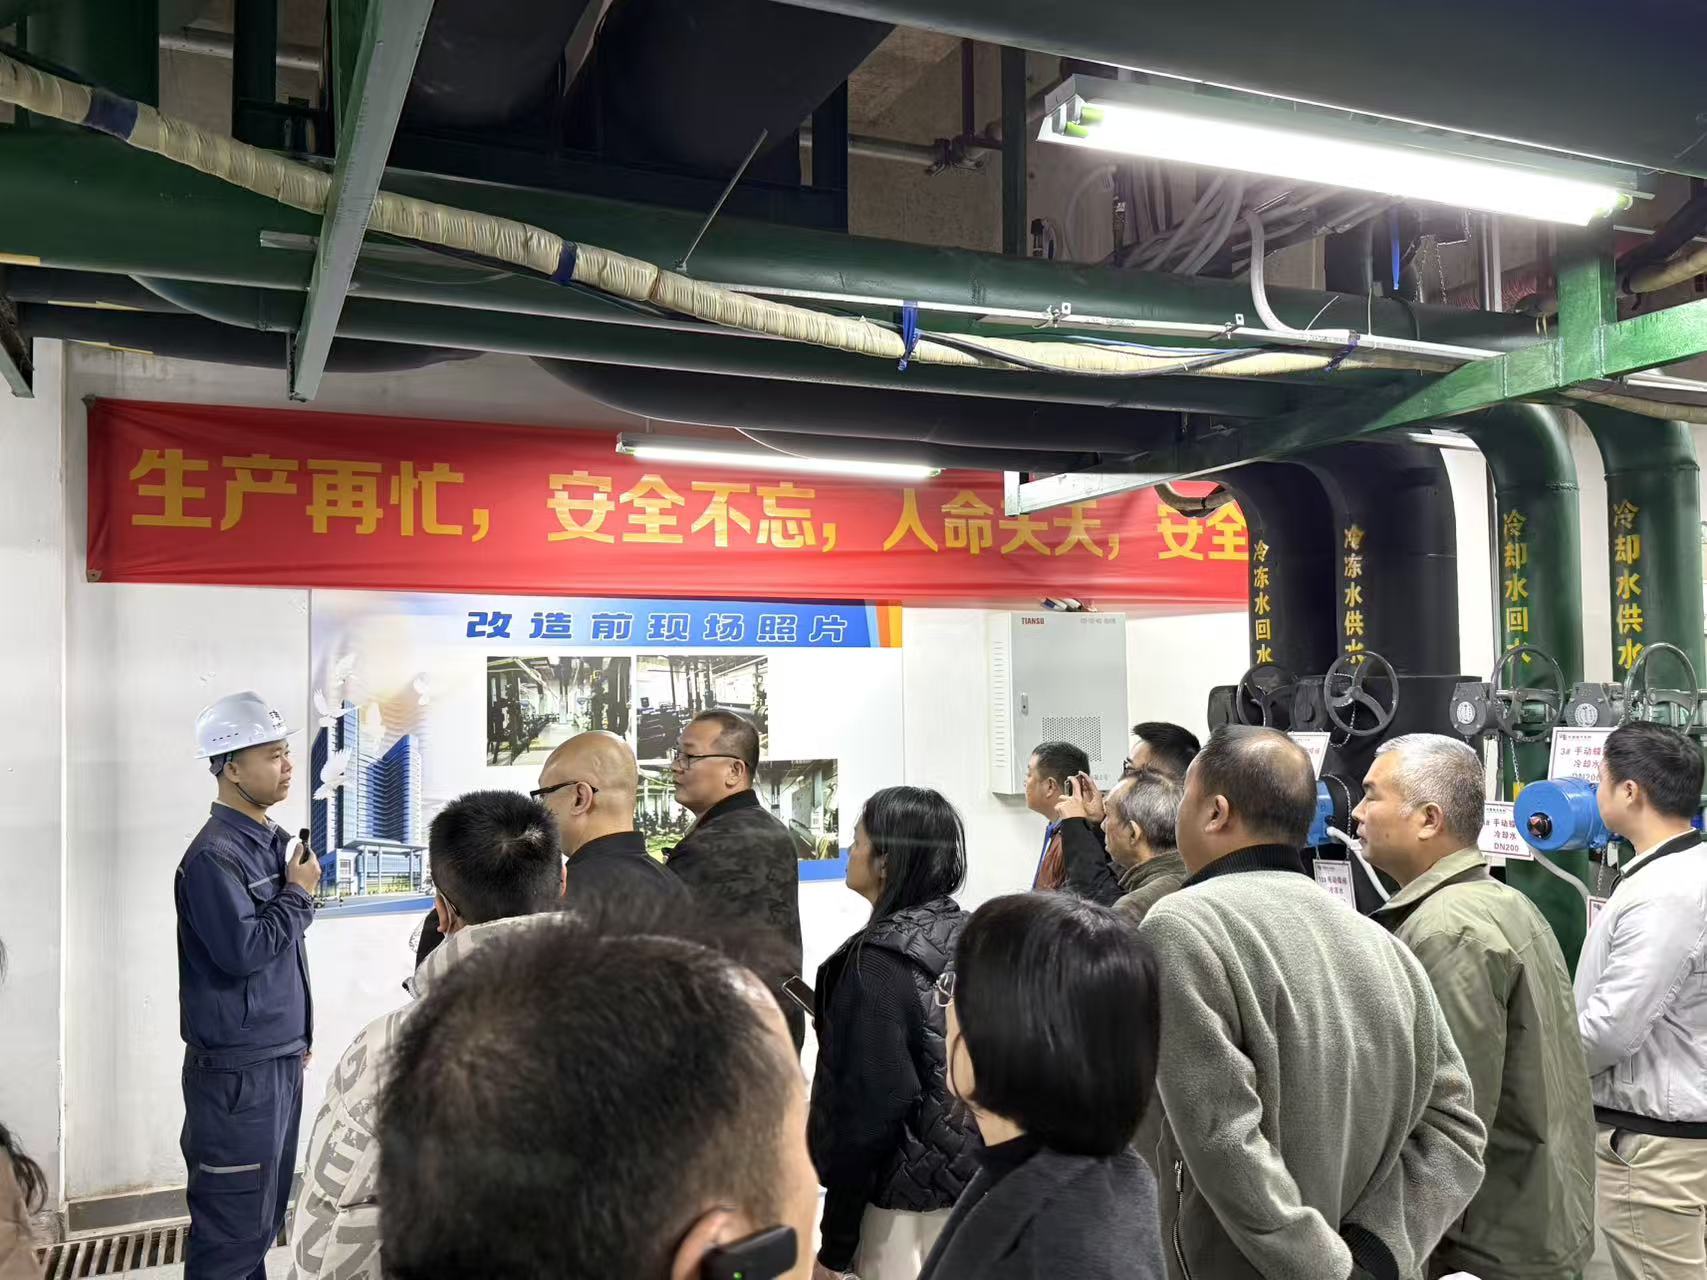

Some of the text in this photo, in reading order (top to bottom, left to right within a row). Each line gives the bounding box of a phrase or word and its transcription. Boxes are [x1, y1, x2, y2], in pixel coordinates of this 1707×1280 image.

[129, 448, 490, 543] 生产再忙，
[546, 470, 837, 553] 安全不忘，
[1253, 539, 1273, 664] 冷冻水回水
[1613, 499, 1644, 670] 冷却水供水
[466, 611, 848, 643] 改造前现场照片
[1494, 830, 1517, 840] 冷却水
[1494, 842, 1519, 853] DN200
